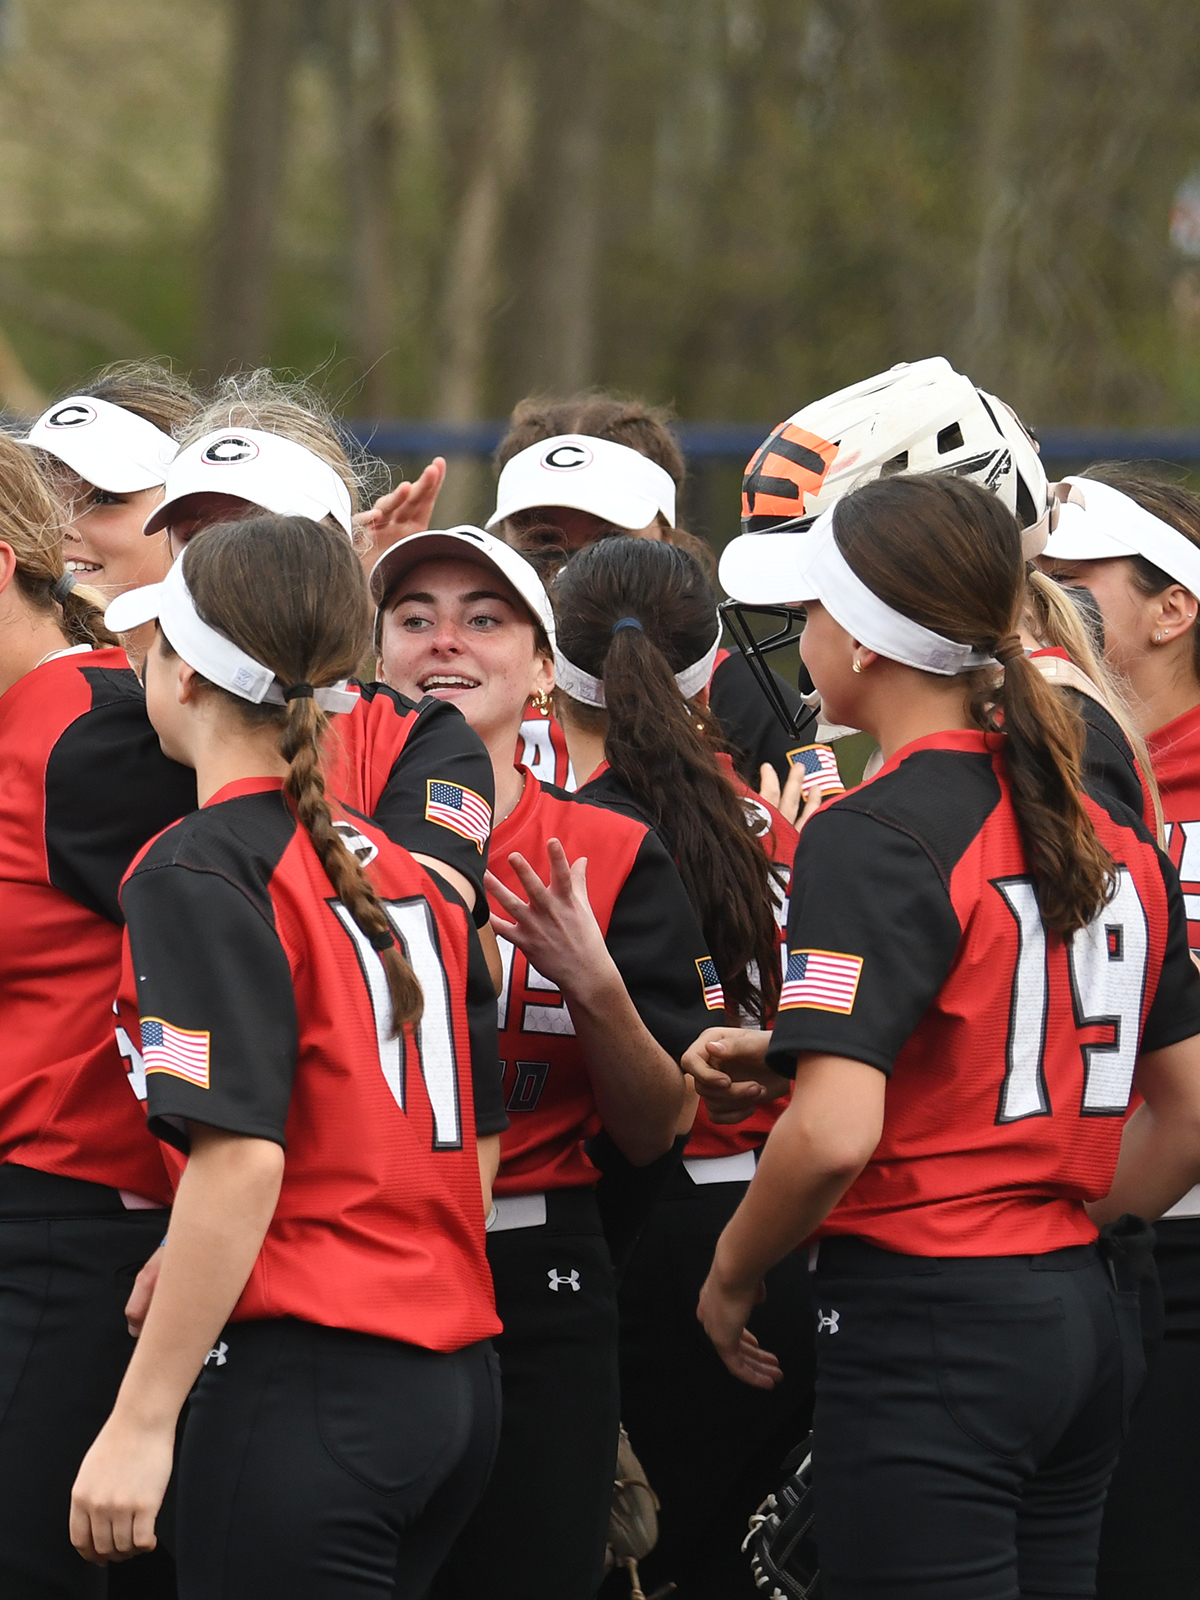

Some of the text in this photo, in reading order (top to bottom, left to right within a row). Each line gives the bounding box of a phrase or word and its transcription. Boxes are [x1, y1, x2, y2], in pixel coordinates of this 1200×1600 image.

[48, 405, 91, 427] C
[205, 437, 252, 463] C
[544, 444, 587, 469] C
[987, 862, 1149, 1126] 19
